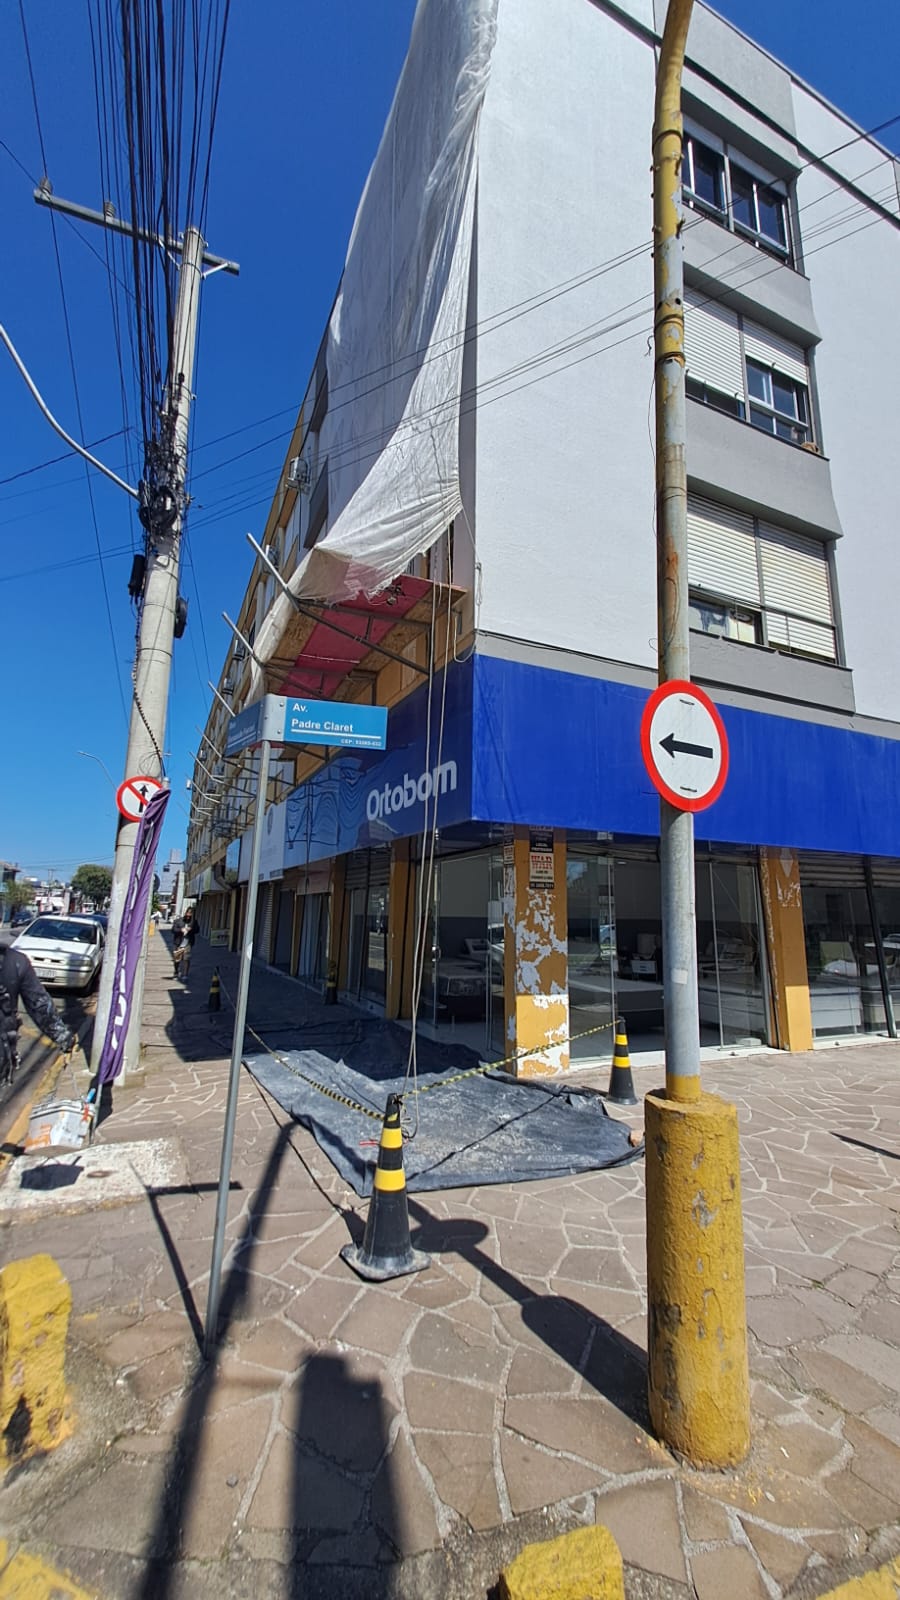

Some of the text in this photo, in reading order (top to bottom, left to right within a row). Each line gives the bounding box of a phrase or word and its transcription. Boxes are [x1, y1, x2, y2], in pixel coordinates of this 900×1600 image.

[292, 703, 308, 712] Av.
[291, 718, 353, 732] Padre Claret
[366, 760, 457, 820] Ortobom
